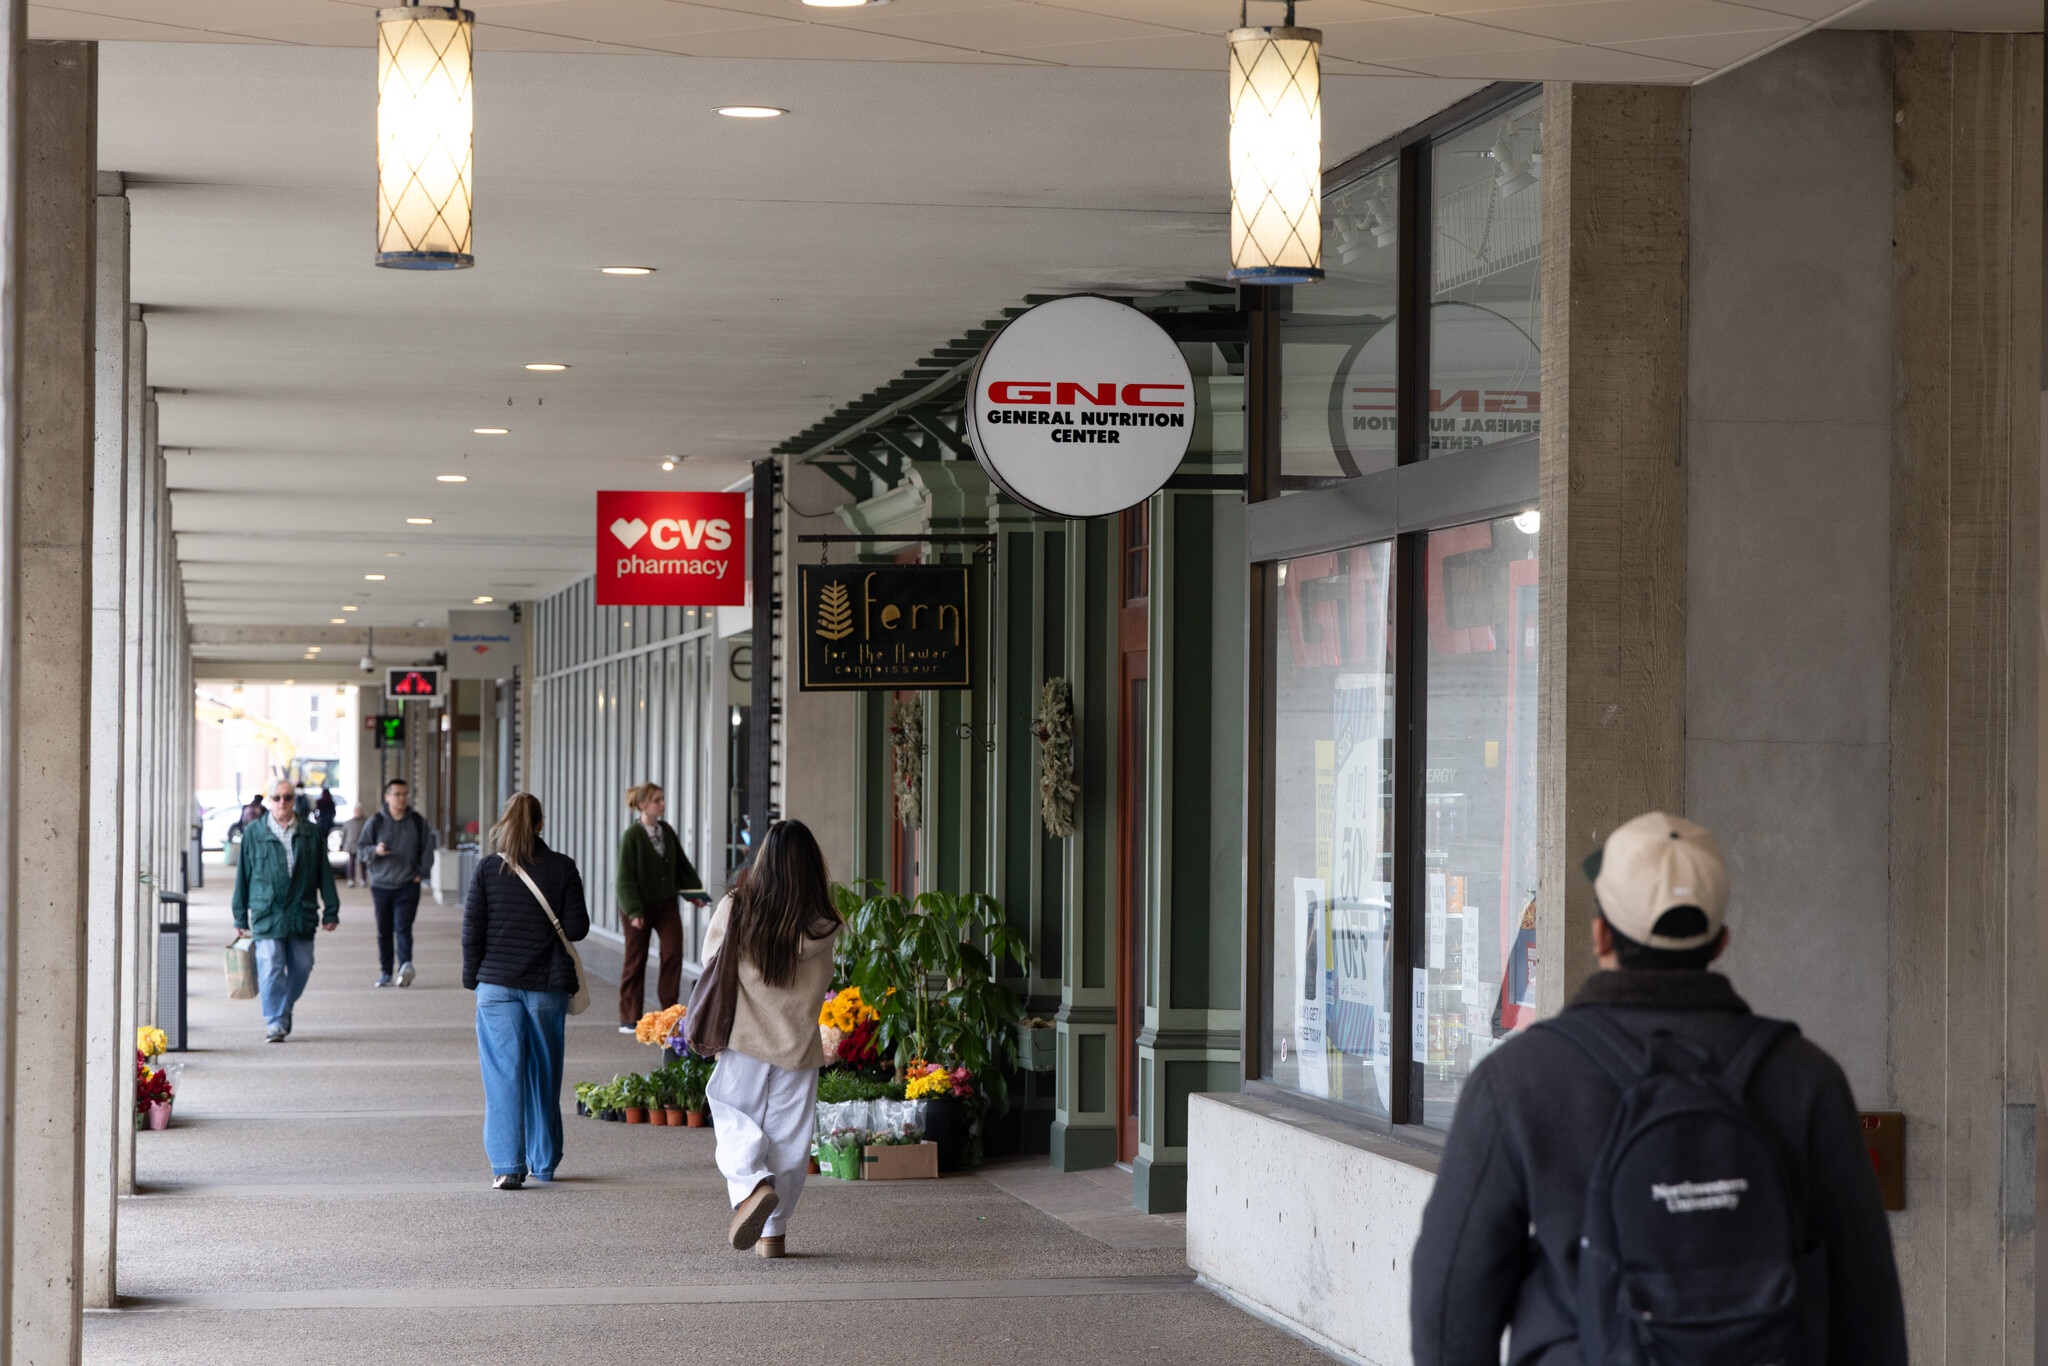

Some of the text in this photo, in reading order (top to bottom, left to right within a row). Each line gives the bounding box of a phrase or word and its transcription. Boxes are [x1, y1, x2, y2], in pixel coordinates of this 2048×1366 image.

[988, 381, 1184, 407] GNC
[987, 410, 1184, 427] GENERAL NUTRITION
[1051, 429, 1120, 444] CENTER
[649, 518, 732, 551] CVS
[617, 554, 728, 580] pharmacy
[864, 571, 960, 646] fern
[824, 643, 949, 665] for the flower
[834, 664, 939, 679] connoisseur
[1427, 767, 1457, 783] ERGY
